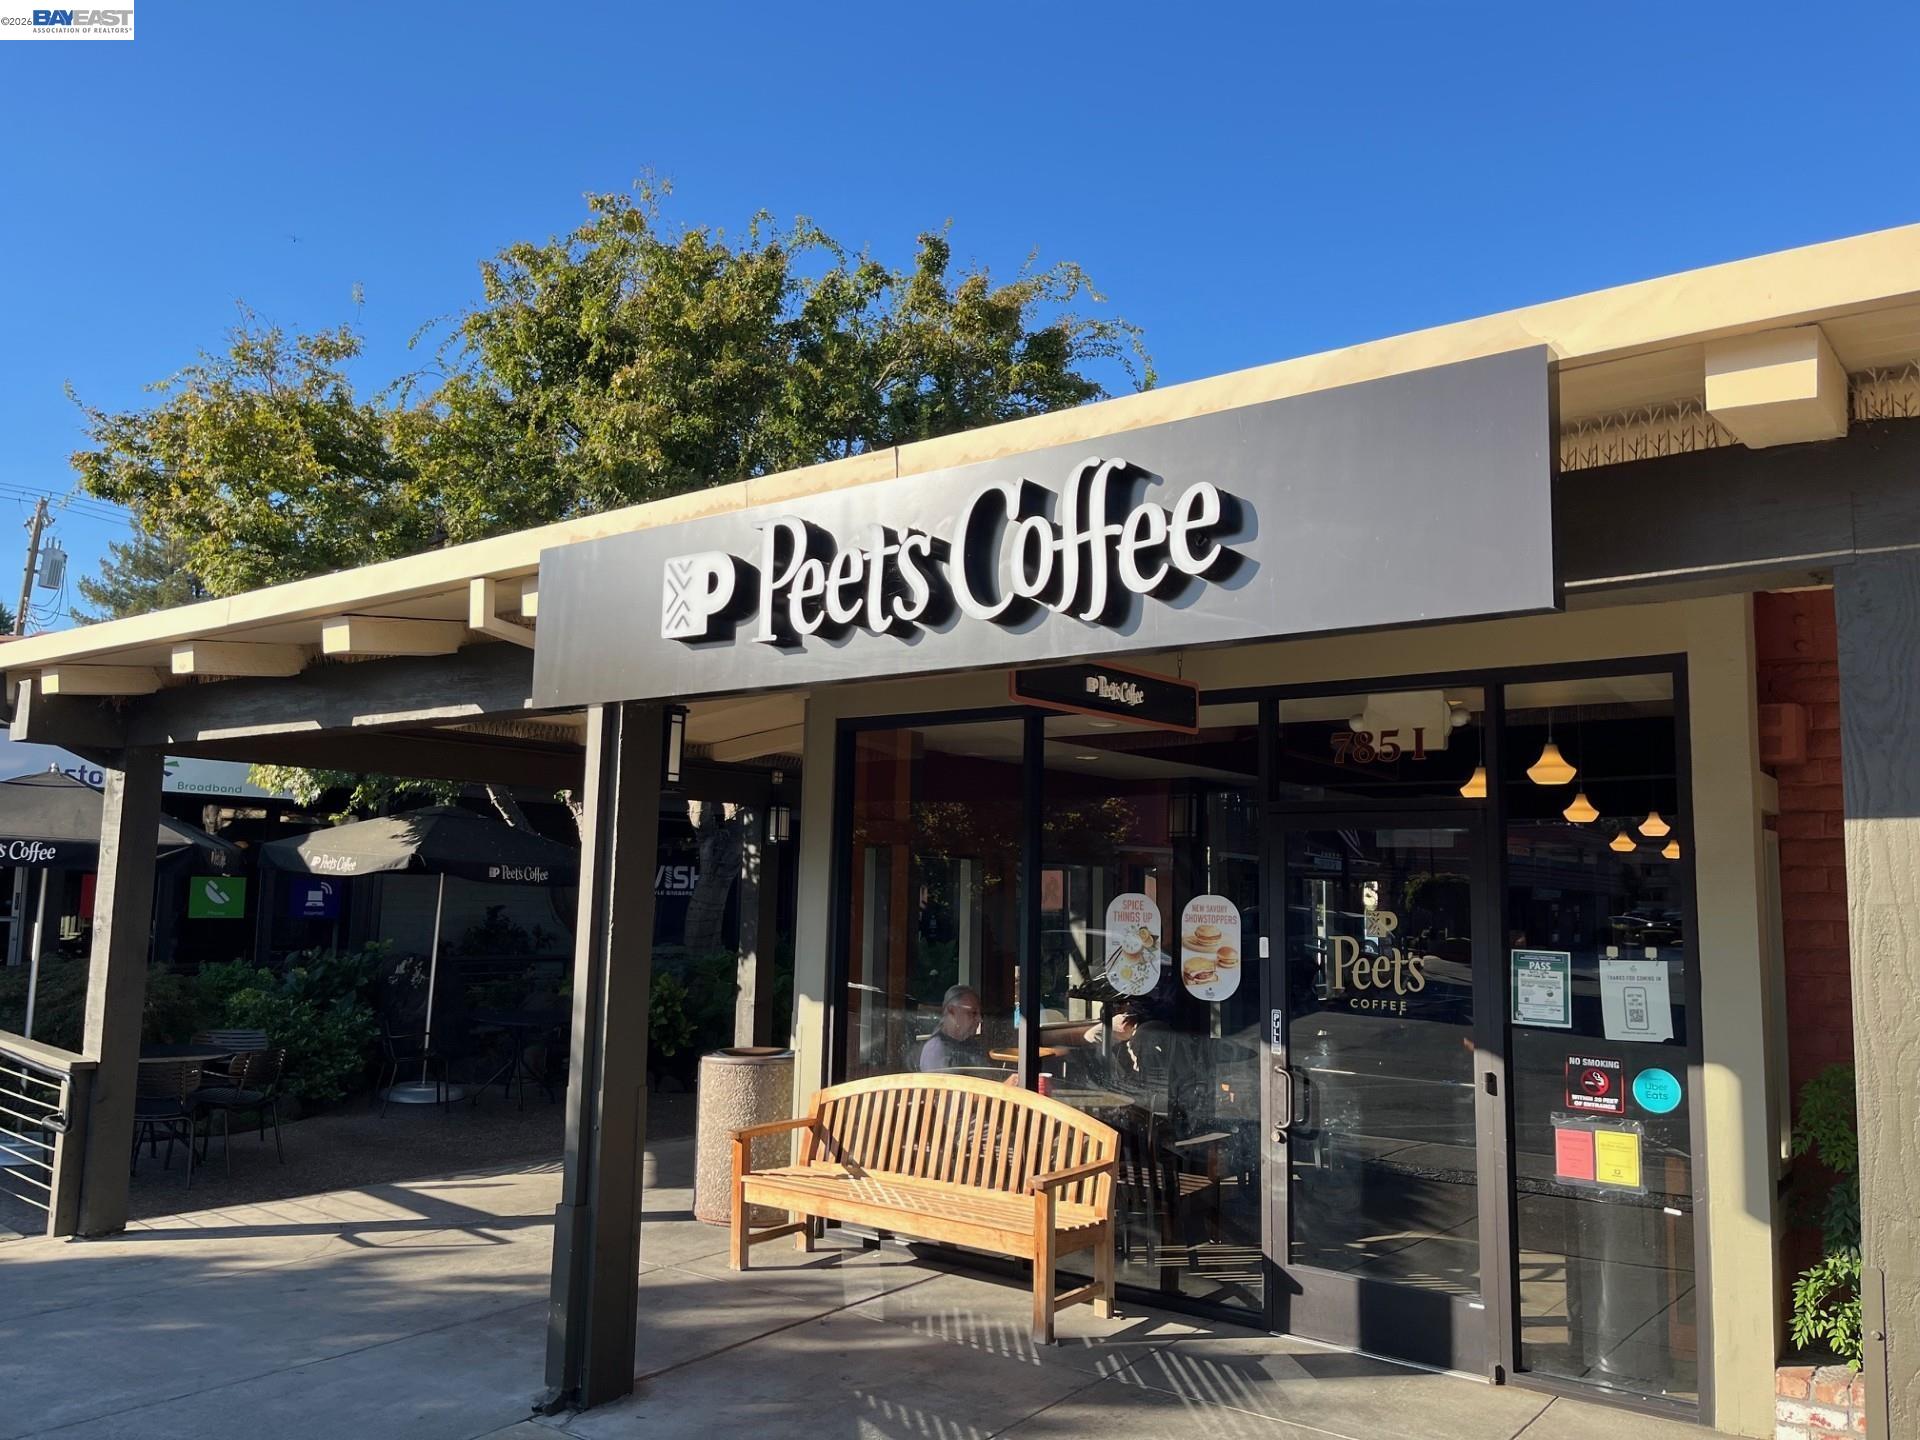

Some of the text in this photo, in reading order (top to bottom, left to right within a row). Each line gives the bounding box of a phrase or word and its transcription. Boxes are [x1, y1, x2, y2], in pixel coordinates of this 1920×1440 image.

[751, 514, 932, 643] Peet's
[949, 455, 1221, 621] Coffee
[1331, 727, 1427, 764] 7851
[176, 781, 243, 795] Broadband
[9, 840, 57, 862] Coffee
[523, 866, 549, 883] Coffee
[1121, 899, 1145, 911] SPICE
[1191, 904, 1228, 914] NEW SAVORY
[1113, 911, 1153, 924] THINGS UP
[1184, 913, 1238, 926] SHOWSTOPPERS
[1327, 935, 1426, 996] Peet's
[1528, 960, 1552, 971] PASS
[1349, 997, 1408, 1012] COFFEE
[1273, 1012, 1281, 1045] PULL
[1568, 1056, 1620, 1070] NO SMOKING
[1644, 1081, 1668, 1091] Uber
[1645, 1090, 1669, 1100] Eats
